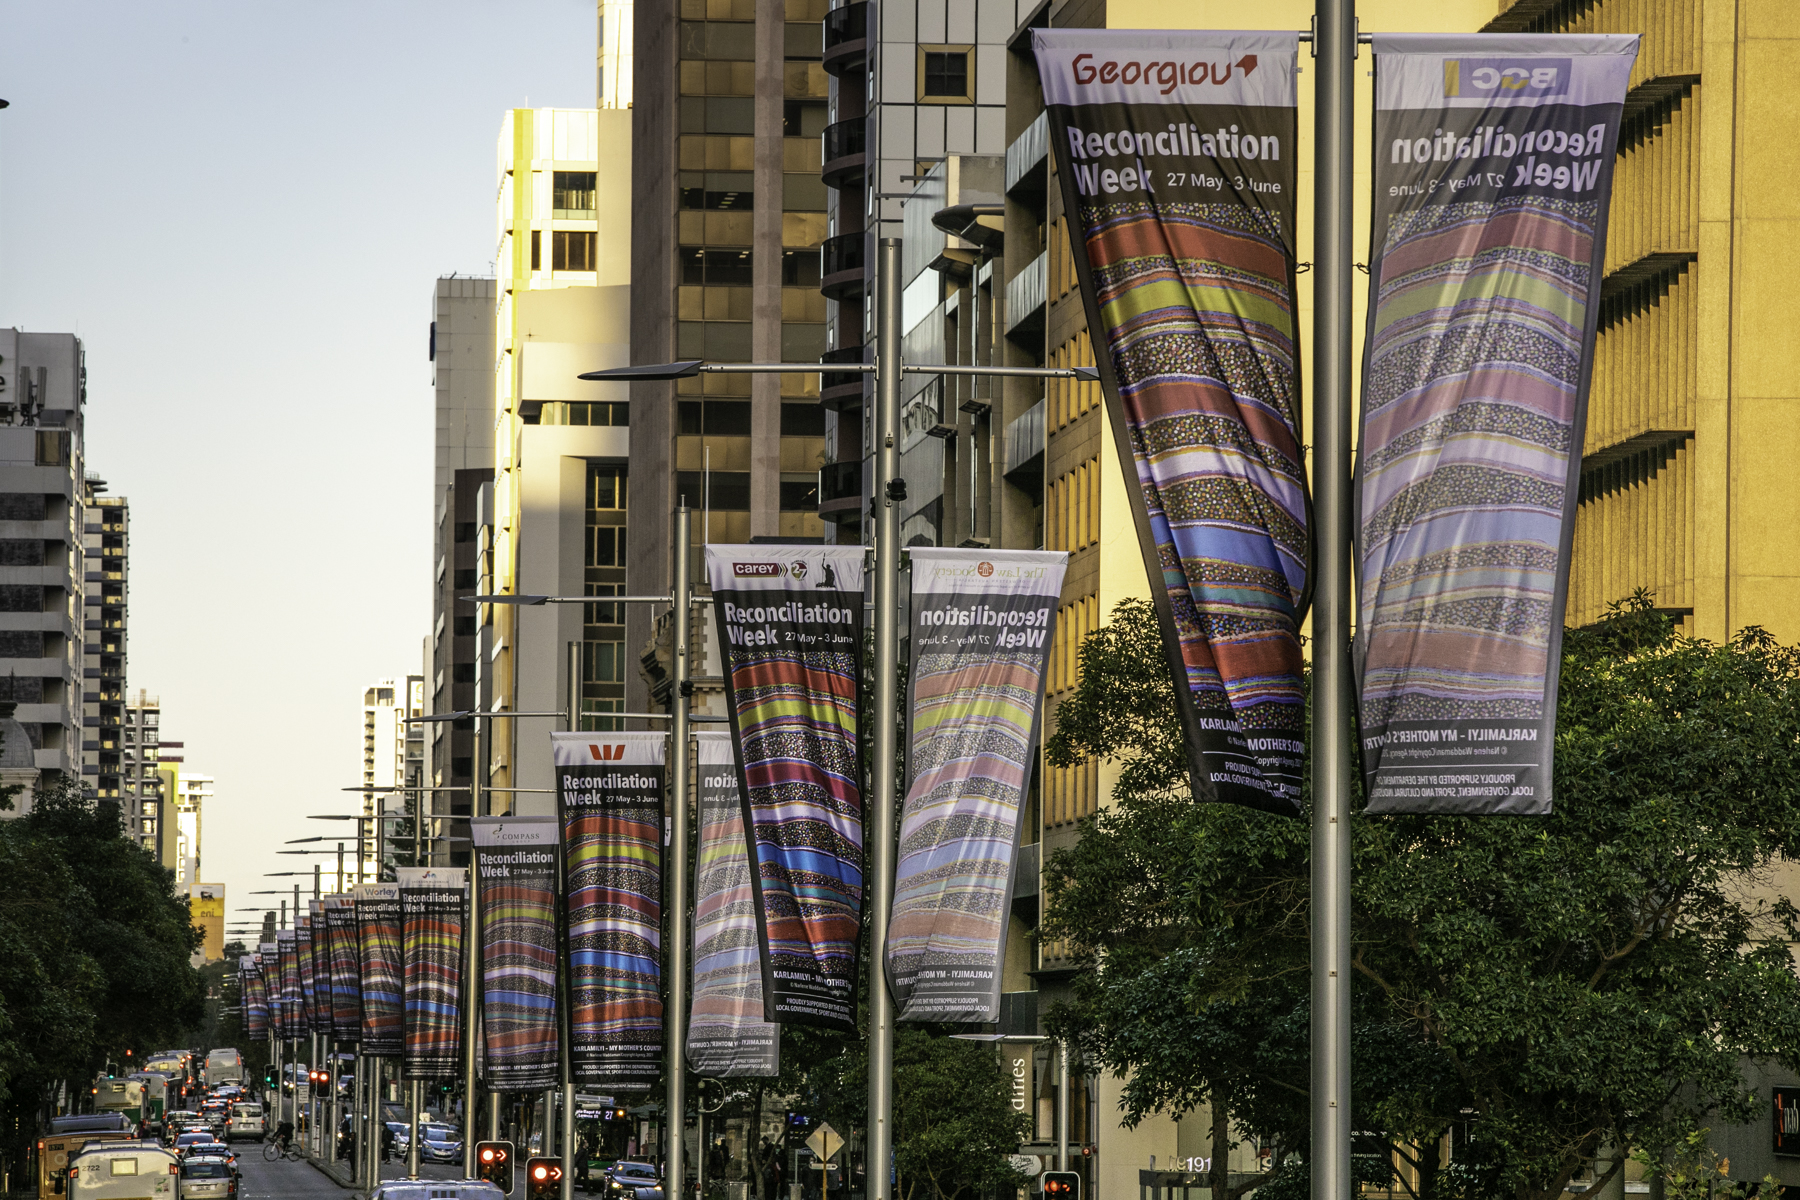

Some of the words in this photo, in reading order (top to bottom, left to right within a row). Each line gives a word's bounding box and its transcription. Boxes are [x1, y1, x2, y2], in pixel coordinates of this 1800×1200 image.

[1072, 53, 1232, 95] Georgiou
[1067, 123, 1280, 161] Reconciliation
[1072, 158, 1156, 197] Week
[1167, 172, 1185, 187] 27
[1191, 173, 1224, 191] May
[1234, 176, 1243, 191] 3
[1248, 177, 1282, 193] June
[724, 601, 853, 624] Reconciliation
[726, 624, 778, 647] Week
[785, 632, 796, 641] 27
[797, 633, 817, 645] May
[825, 633, 830, 642] 3
[832, 633, 853, 644] June
[563, 773, 658, 790] Reconciliation
[1210, 772, 1232, 783] LOCAL
[564, 790, 602, 806] Week
[616, 795, 631, 804] May
[642, 795, 659, 803] June
[502, 833, 540, 841] COMPASS
[480, 851, 554, 865] Reconciliation
[480, 865, 510, 878] Week
[365, 888, 397, 898] Worley
[403, 893, 460, 903] Reconciliation
[201, 908, 215, 918] eni
[403, 903, 426, 913] Week
[358, 912, 378, 921] Week
[605, 1111, 614, 1120] 27
[1186, 1156, 1211, 1172] 191
